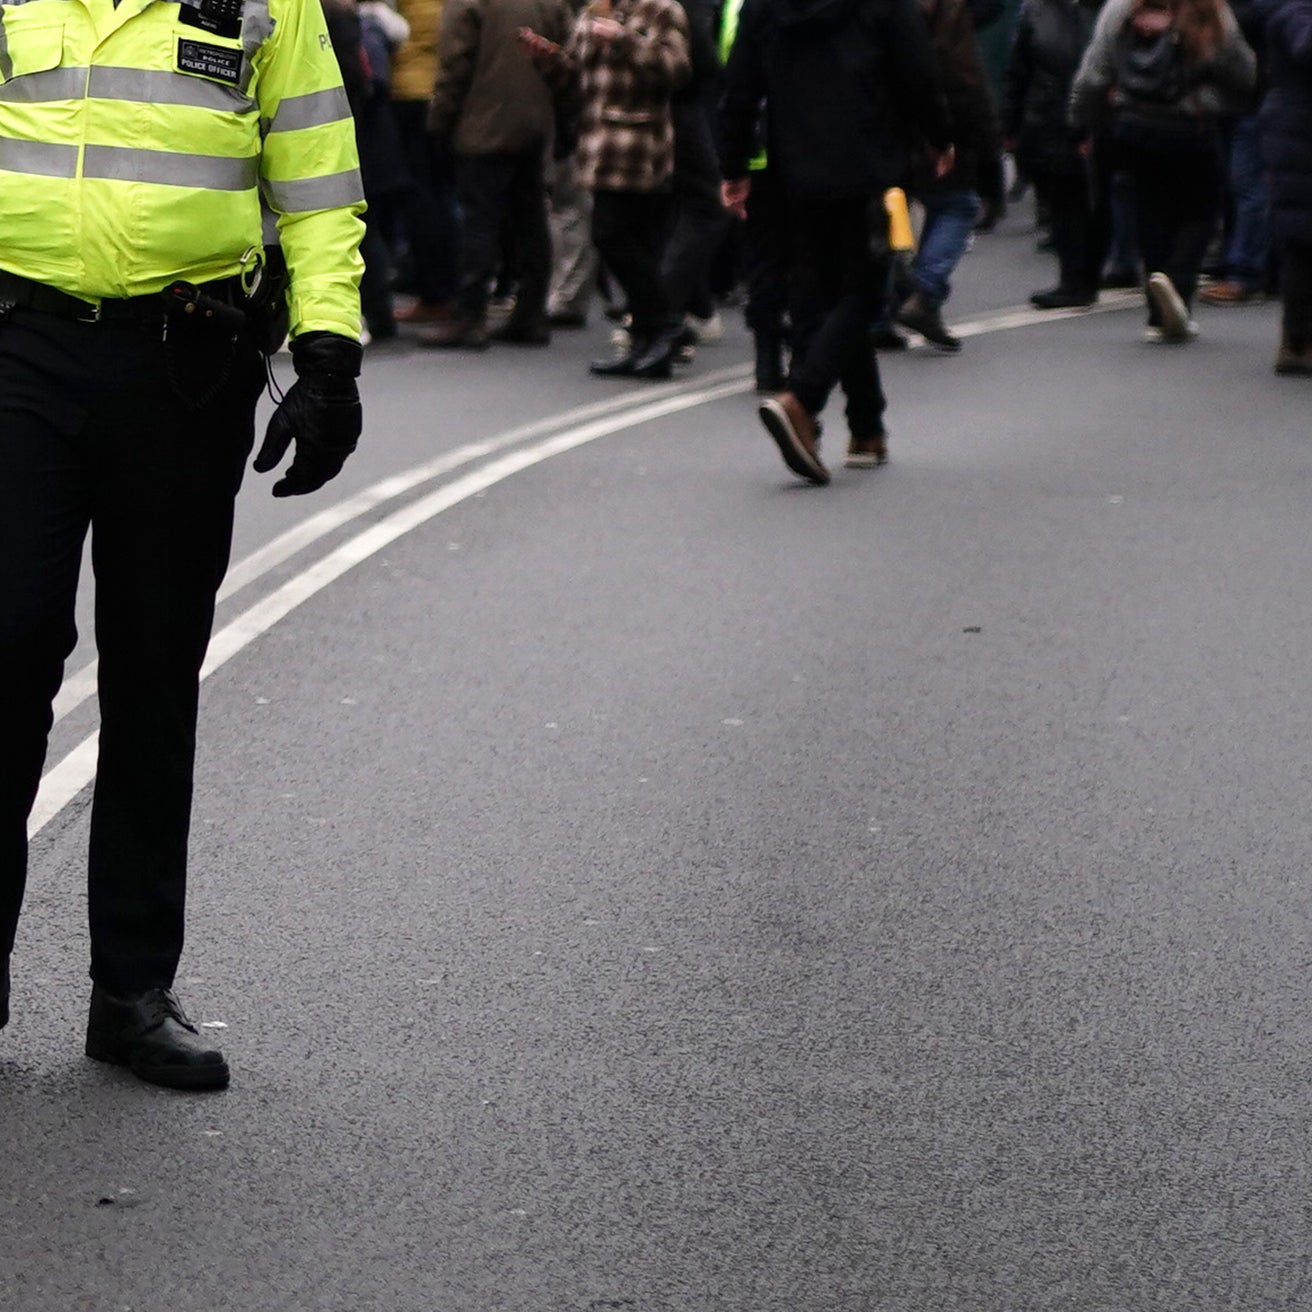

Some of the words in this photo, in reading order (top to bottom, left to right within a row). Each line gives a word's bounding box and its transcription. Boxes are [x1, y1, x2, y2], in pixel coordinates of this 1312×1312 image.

[181, 58, 207, 71] POLICE
[207, 64, 237, 79] OFFICER
[202, 55, 230, 66] POLICE
